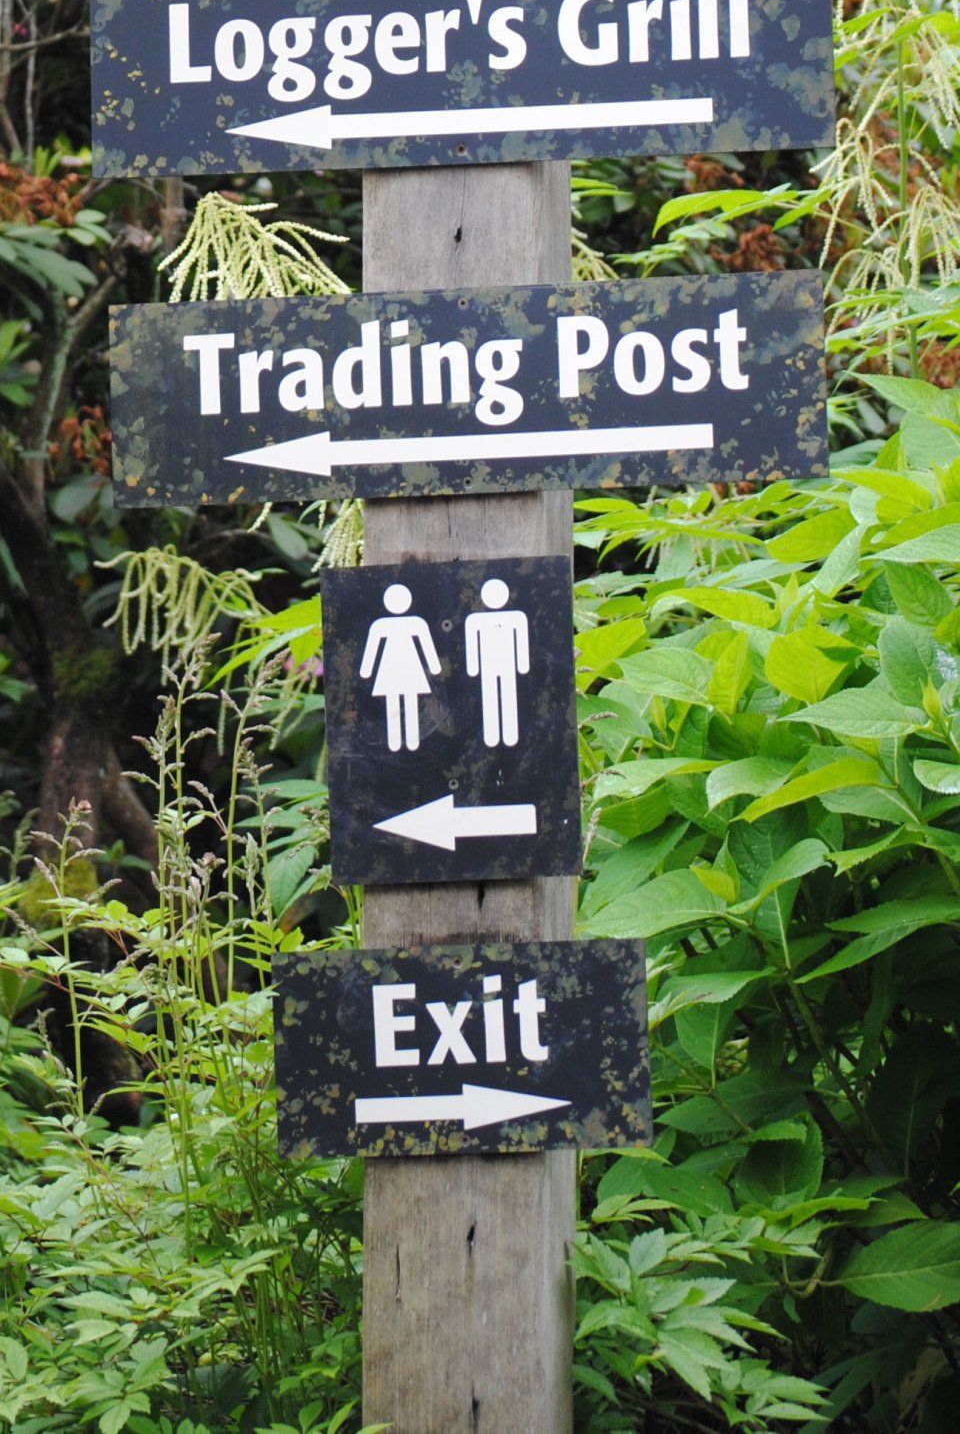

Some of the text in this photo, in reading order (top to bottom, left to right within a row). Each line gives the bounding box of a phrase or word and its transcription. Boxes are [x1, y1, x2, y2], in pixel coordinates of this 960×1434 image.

[182, 308, 750, 427] Trading Post
[372, 974, 549, 1068] Exit
